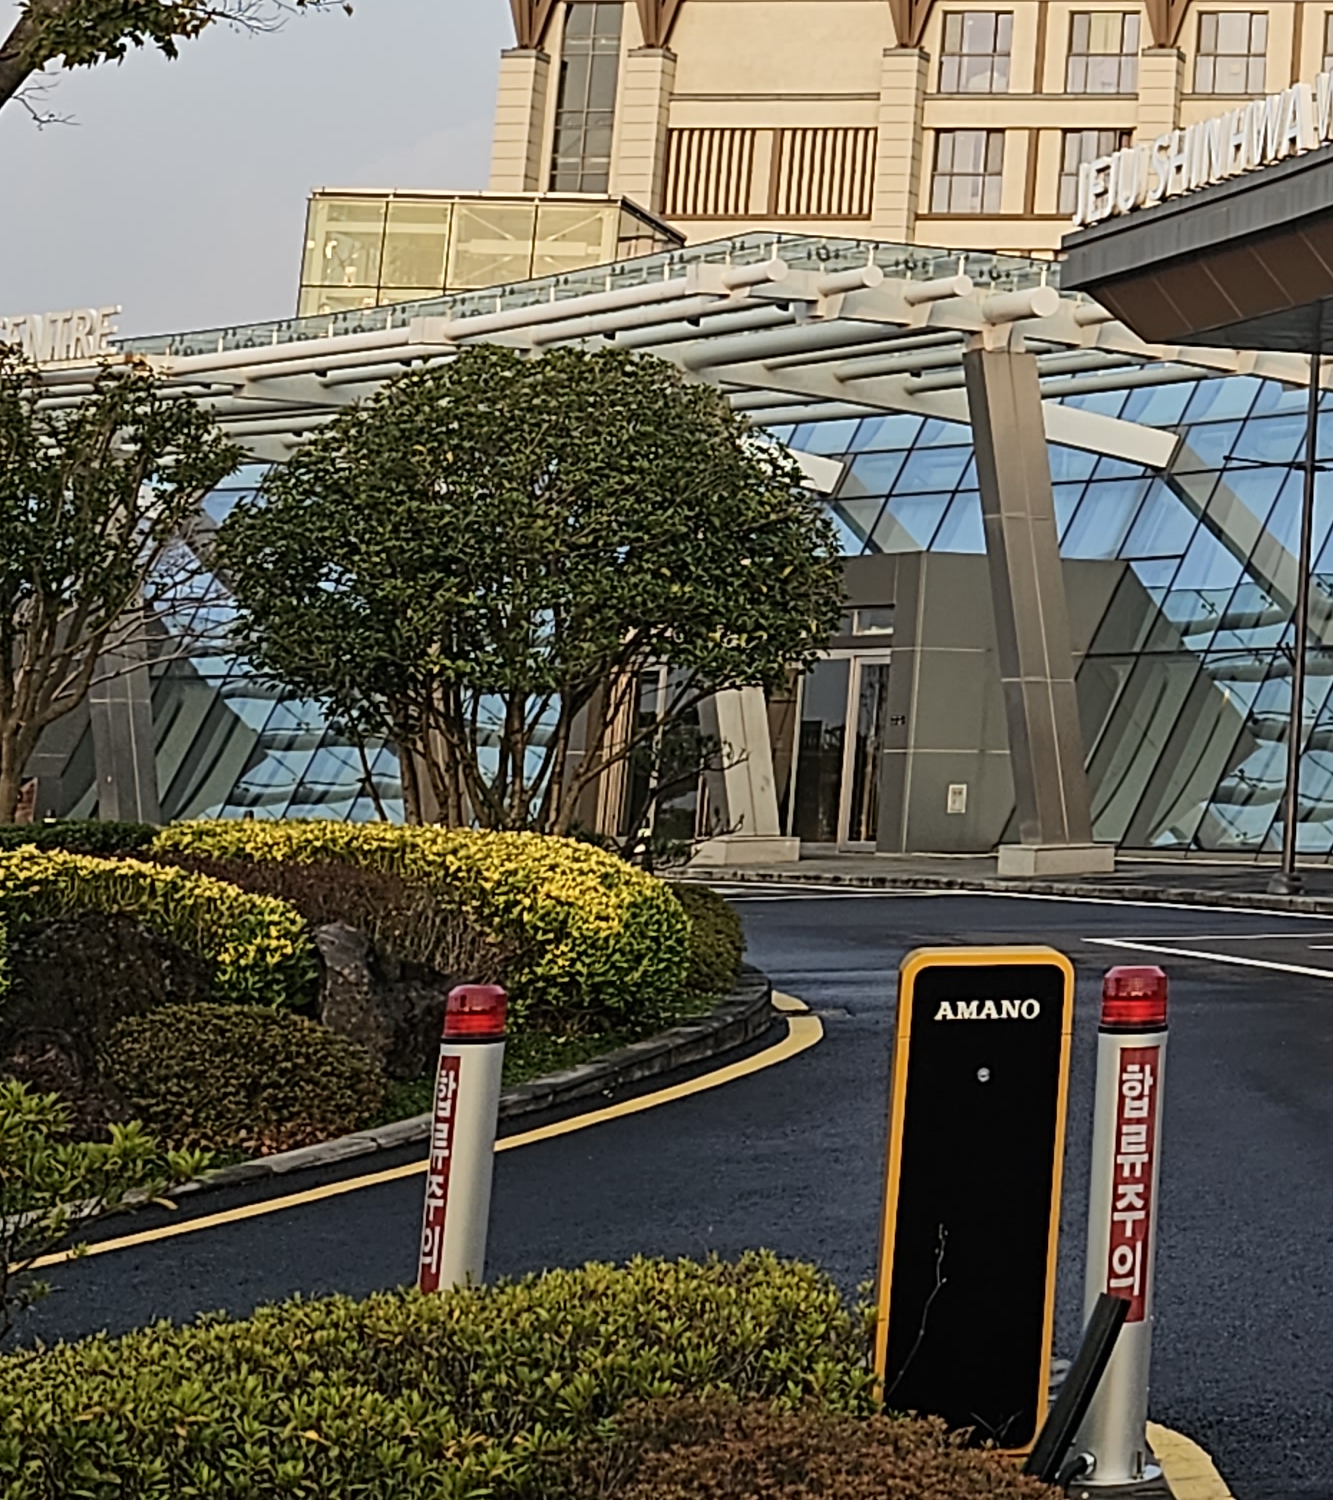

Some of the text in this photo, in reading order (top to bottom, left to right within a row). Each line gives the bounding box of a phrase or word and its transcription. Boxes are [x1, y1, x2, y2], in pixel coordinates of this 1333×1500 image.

[1072, 146, 1150, 227] JEJU
[1149, 83, 1318, 201] SHINHWA
[0, 305, 122, 361] ENTRE
[933, 998, 1041, 1021] AMANO
[421, 1069, 457, 1275] 합류주의
[1109, 1063, 1154, 1297] 합류주의
